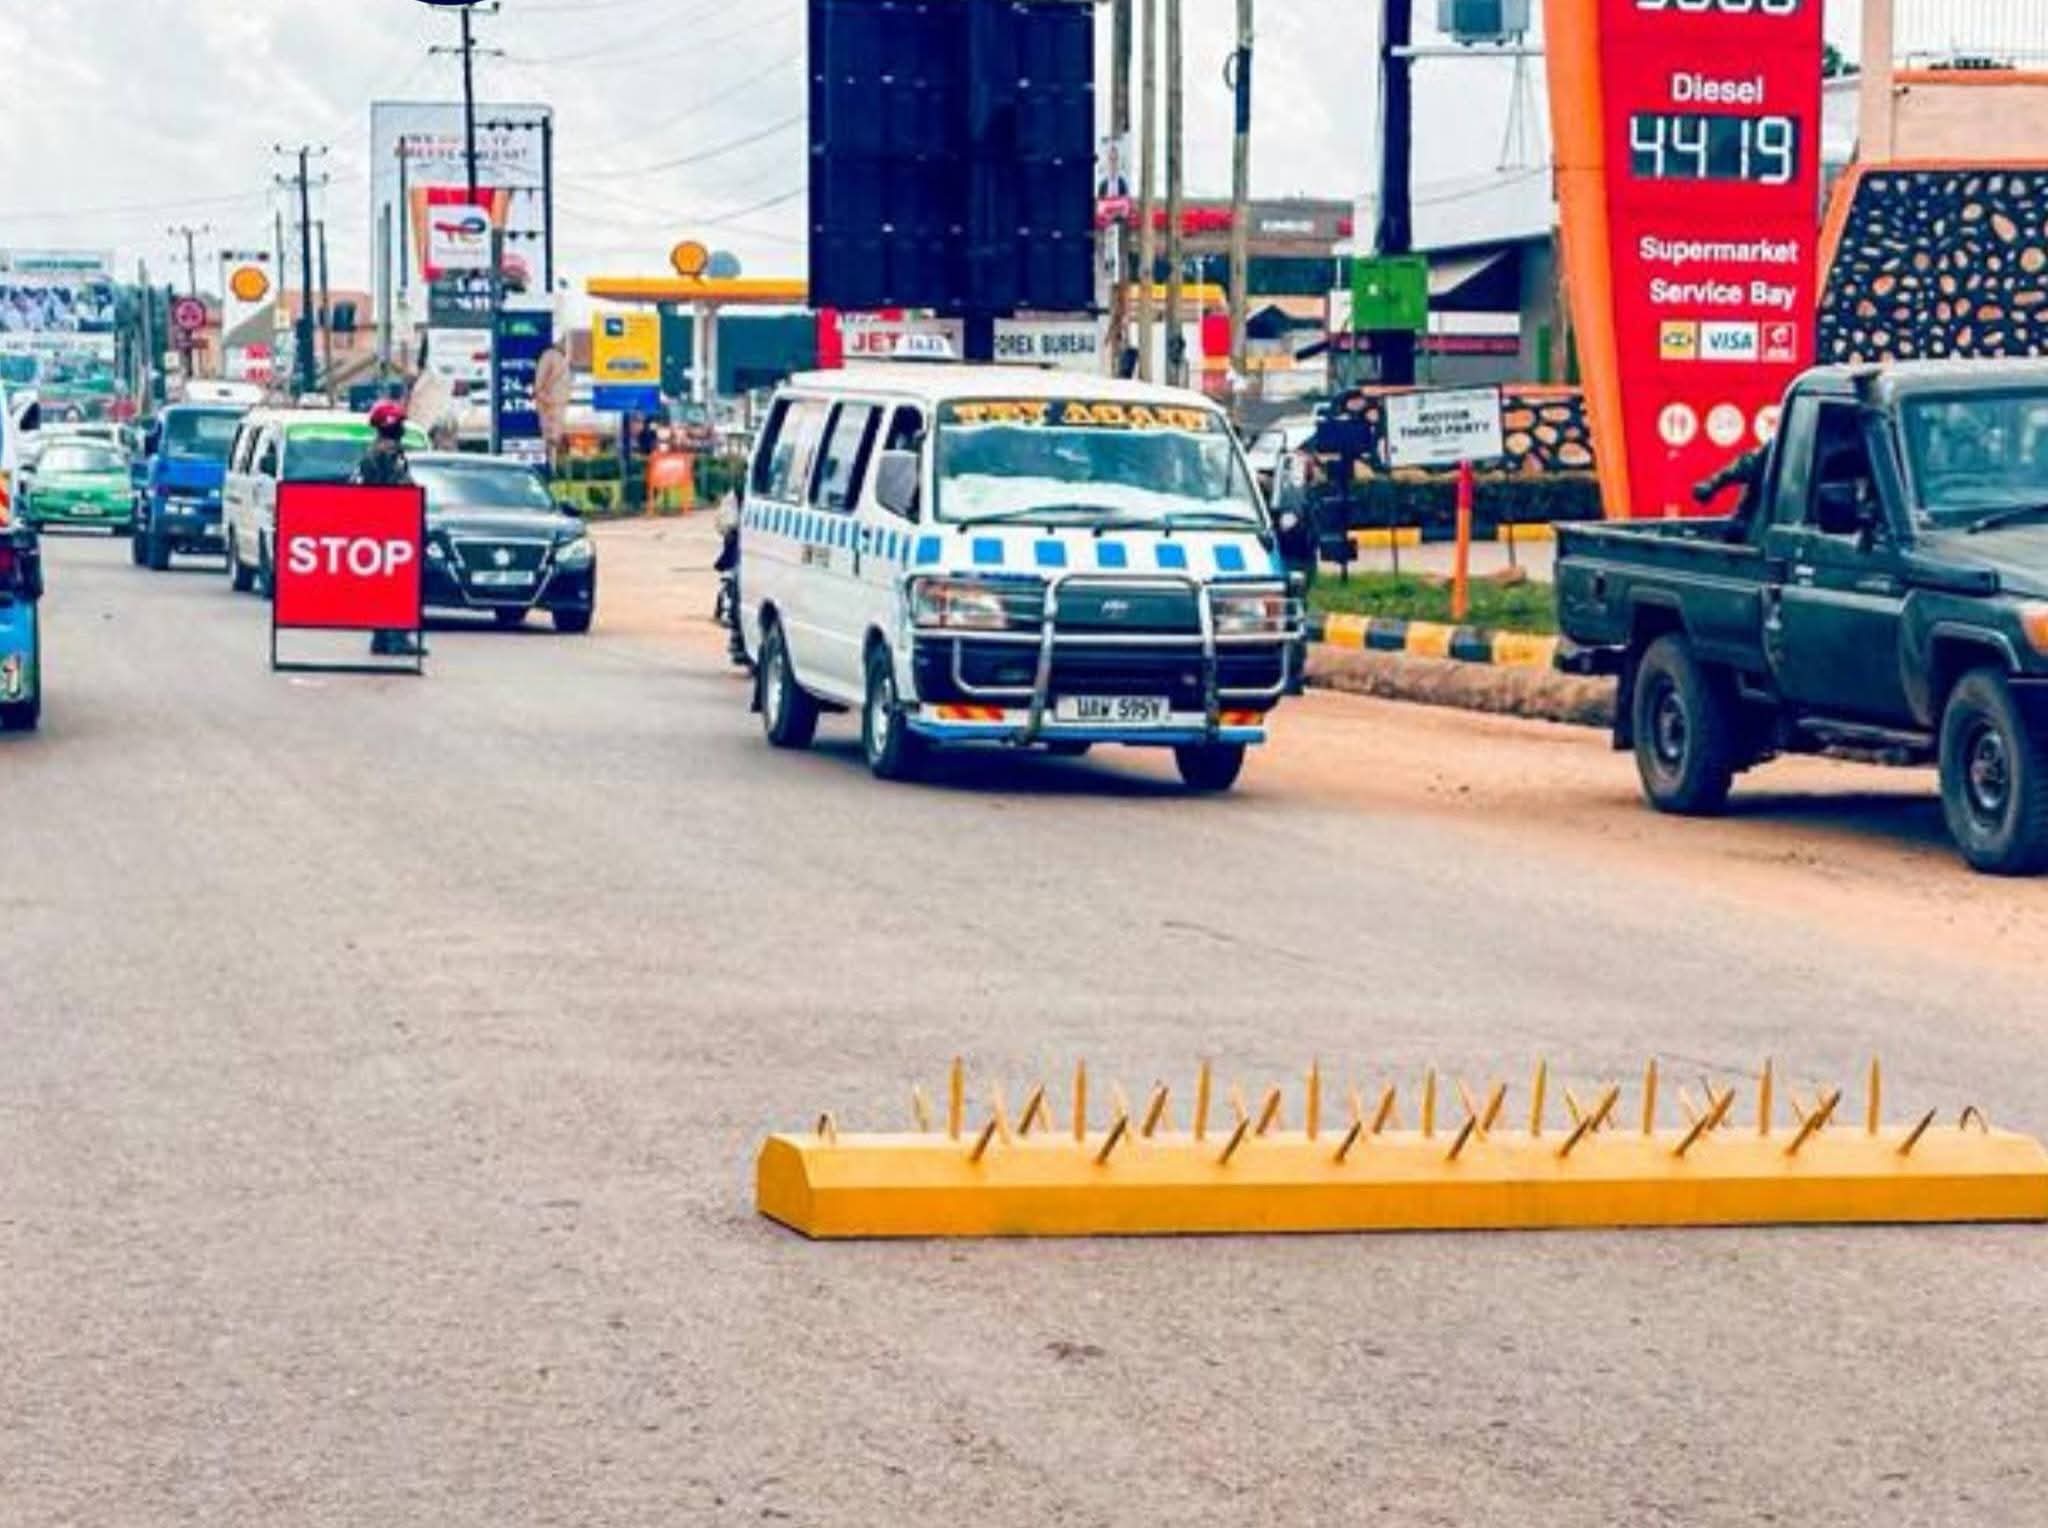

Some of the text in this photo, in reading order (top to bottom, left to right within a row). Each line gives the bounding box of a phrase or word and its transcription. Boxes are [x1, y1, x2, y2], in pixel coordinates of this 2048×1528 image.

[1672, 72, 1764, 104] Diesel
[1630, 115, 1793, 185] 4419
[1639, 235, 1799, 267] Supermarket
[1650, 277, 1796, 311] Service Bay
[1041, 333, 1095, 354] BUREAU
[1708, 331, 1753, 350] VISA
[1445, 422, 1490, 435] PARTY
[288, 536, 414, 576] STOP
